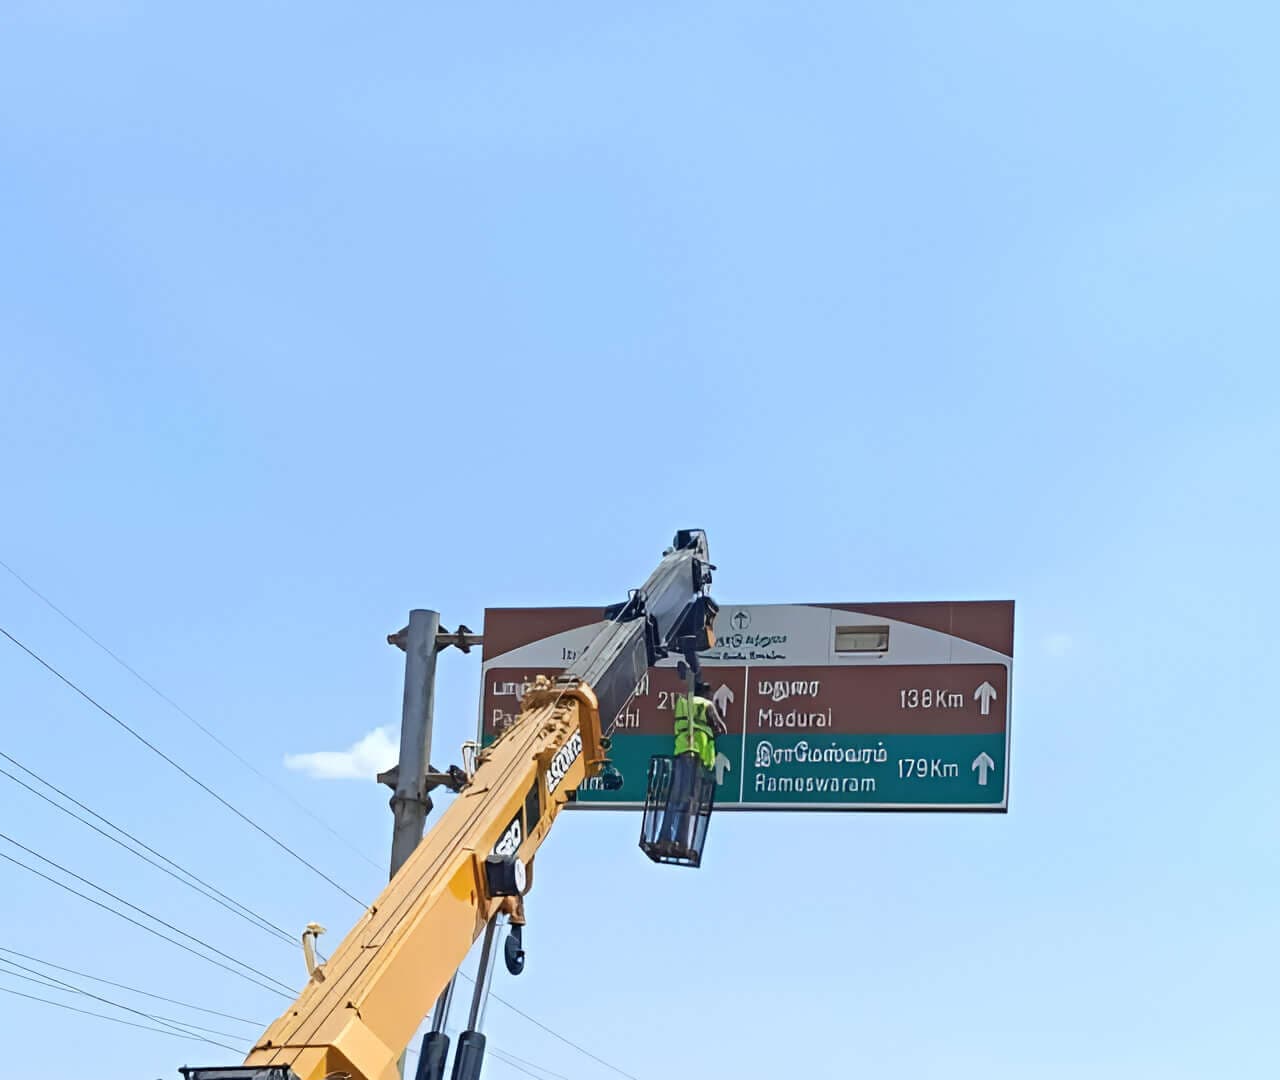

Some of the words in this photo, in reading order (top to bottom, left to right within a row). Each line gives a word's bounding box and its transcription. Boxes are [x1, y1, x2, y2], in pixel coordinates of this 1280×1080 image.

[758, 680, 819, 701] மதுரை
[758, 707, 832, 728] Madurai
[754, 740, 888, 768] இராமேஸ்வரம்
